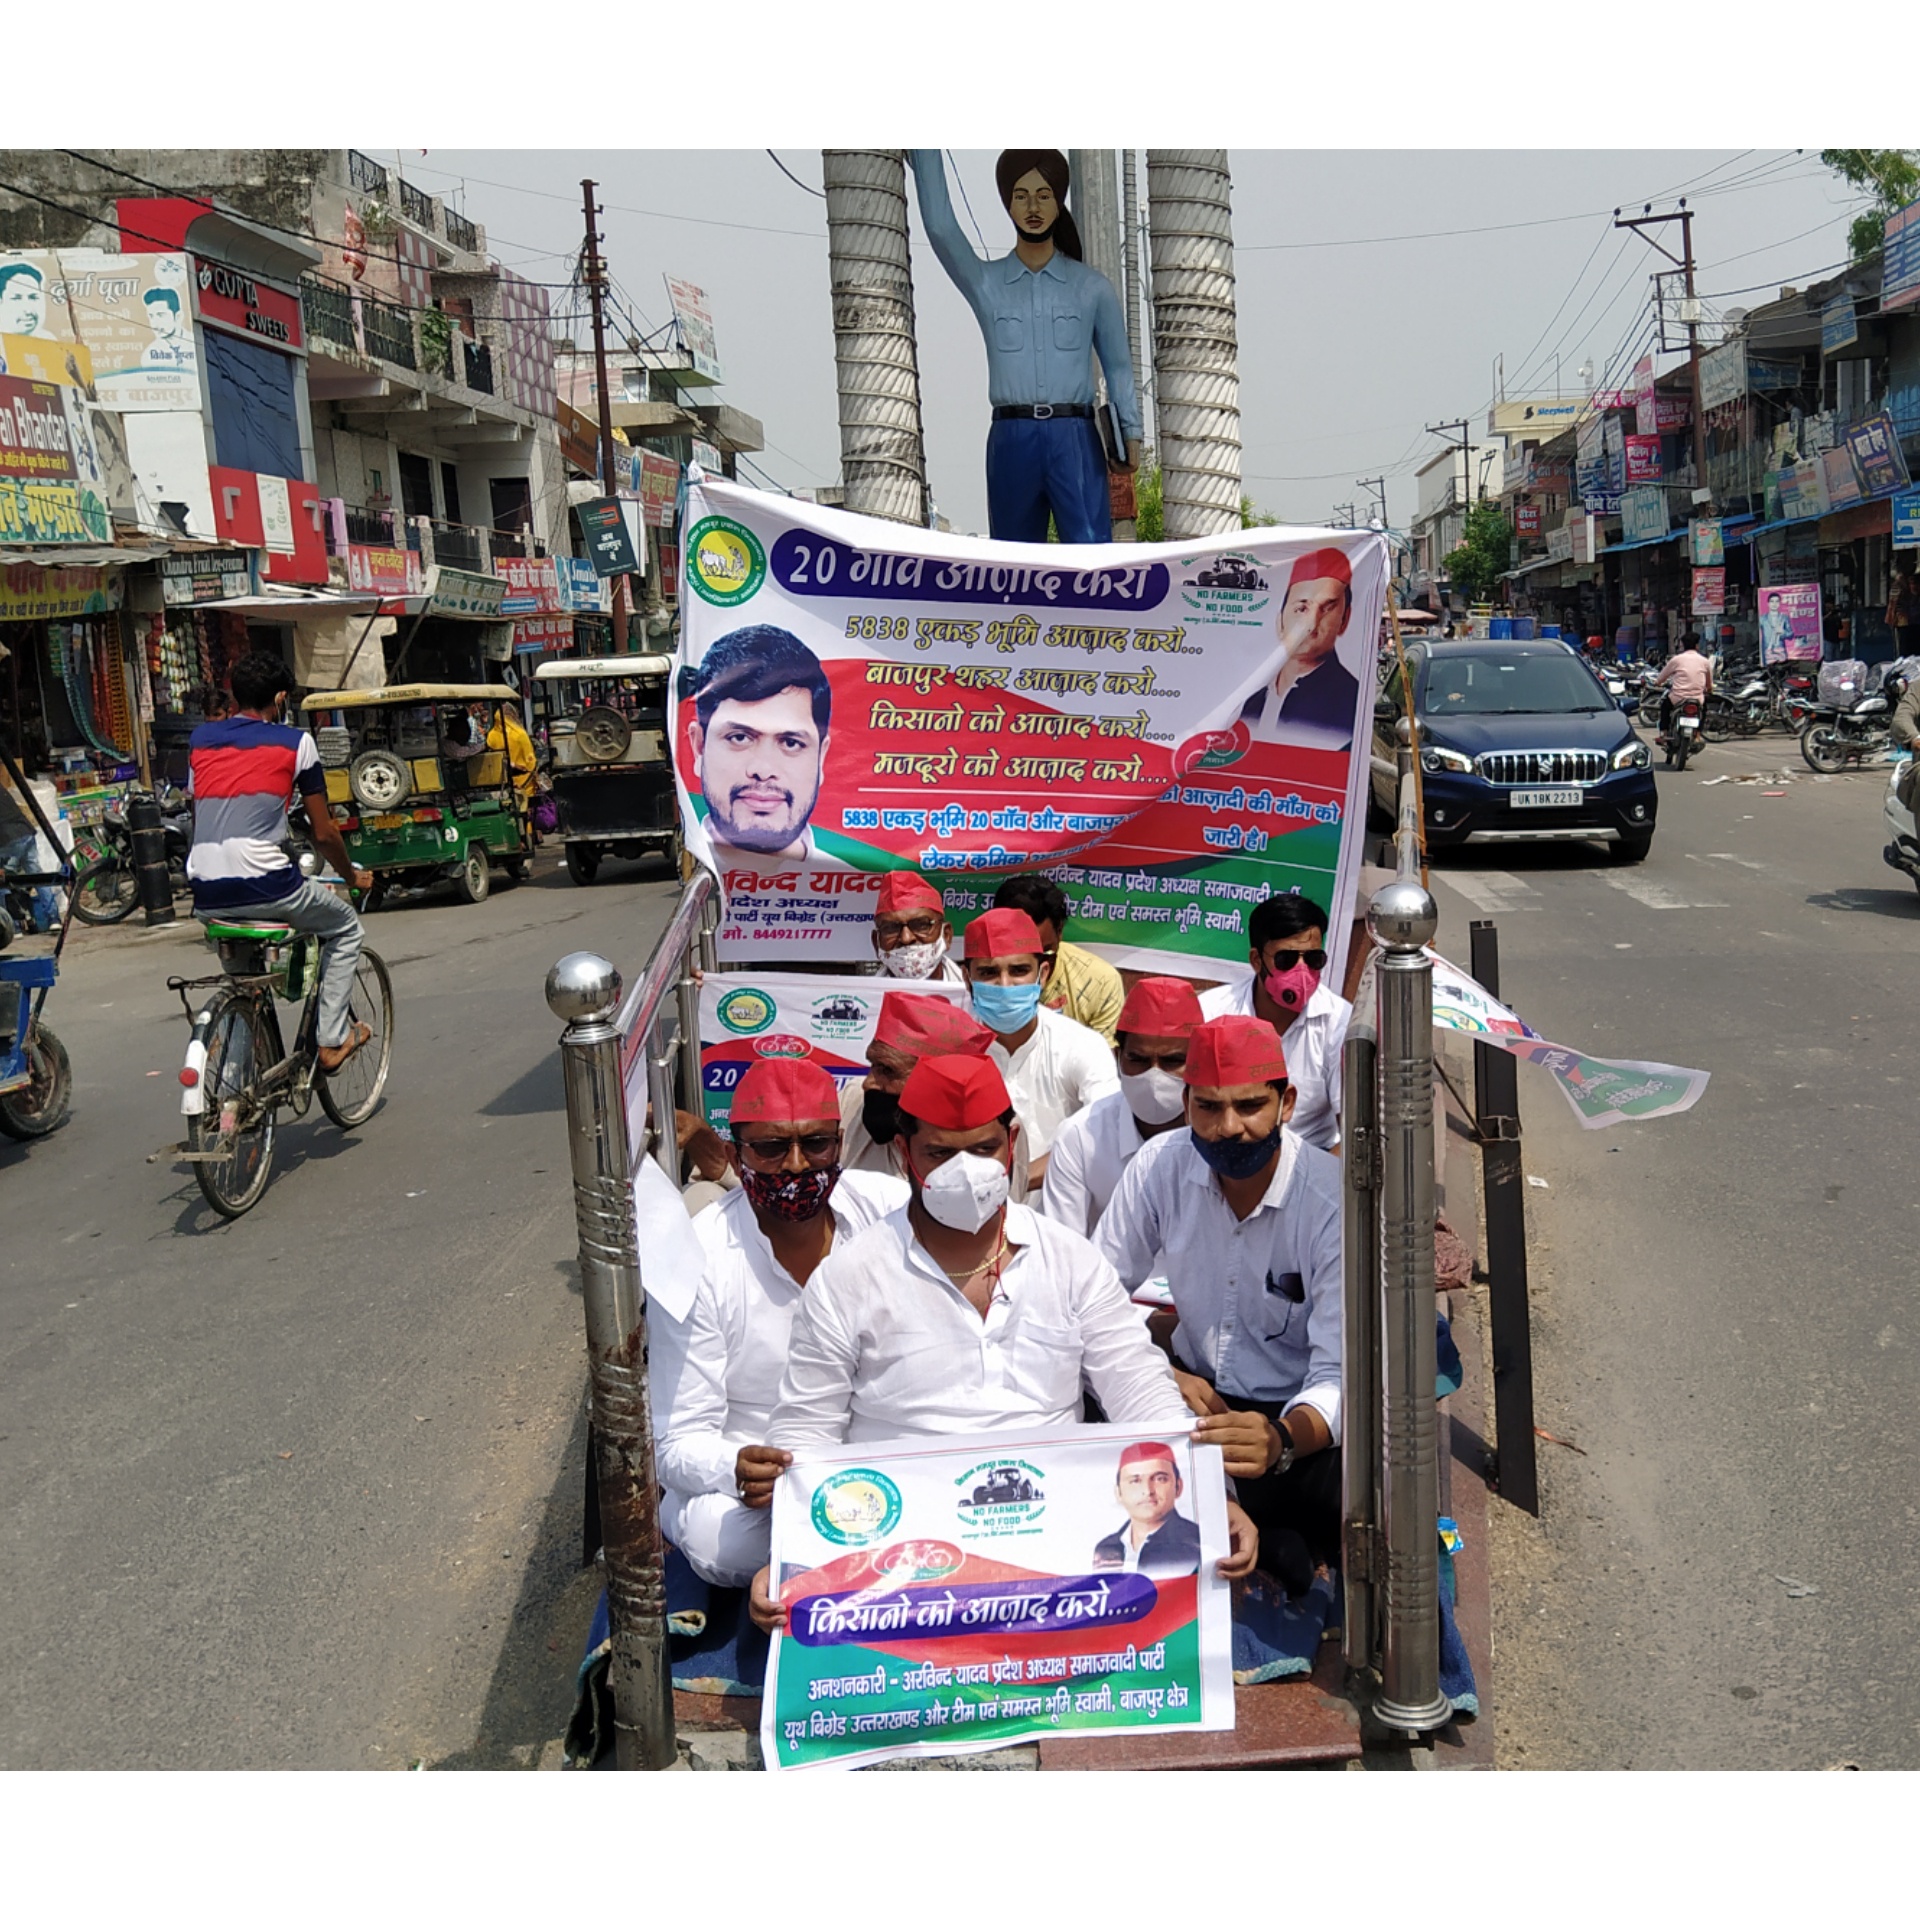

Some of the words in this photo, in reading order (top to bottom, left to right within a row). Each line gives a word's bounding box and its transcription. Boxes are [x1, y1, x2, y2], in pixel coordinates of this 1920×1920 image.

[99, 277, 141, 303] पूजा
[213, 267, 259, 308] GUPTA
[247, 312, 290, 342] SWEETS
[13, 396, 69, 452] Bhandar
[1537, 405, 1576, 416] Sleepwell
[790, 546, 837, 584] 20
[1197, 590, 1208, 599] NO
[1212, 591, 1254, 602] FARMERS
[1206, 603, 1217, 612] NO
[1220, 603, 1243, 613] FOOD
[845, 615, 909, 641] 5838
[916, 617, 982, 650] एकड़
[985, 613, 1041, 653] भूमि
[1043, 624, 1130, 655] आज़ाद
[865, 661, 950, 695] बाजपुर
[955, 665, 1011, 690] शहर
[1014, 667, 1100, 699] आज़ाद
[868, 699, 965, 732] किसानो
[968, 704, 1007, 735] को
[1009, 712, 1096, 743] आज़ाद
[872, 747, 958, 784] मजदूरो
[962, 748, 1000, 779] को
[1003, 753, 1089, 787] आज़ाद
[842, 808, 878, 829] 5838
[882, 808, 926, 834] एकड़
[930, 802, 966, 837] भूमि
[970, 809, 989, 830] 20
[1030, 804, 1064, 832] और
[1248, 789, 1273, 815] की
[1315, 798, 1341, 824] को
[1517, 792, 1531, 805] UK
[1533, 791, 1552, 806] 18K
[1553, 791, 1580, 805] 2213
[920, 843, 968, 870] लेकर
[1203, 823, 1242, 848] जारी
[722, 869, 803, 894] विन्द
[810, 870, 885, 895] यादव
[1088, 869, 1122, 891] यादव
[1125, 871, 1158, 893] प्रदेश
[1159, 875, 1200, 896] अध्यक्ष
[1203, 880, 1272, 904] समाजवादी
[734, 910, 759, 923] पार्टी
[775, 897, 839, 910] अध्यक्ष
[1081, 898, 1106, 920] टीम
[1107, 899, 1130, 921] एवं
[1131, 903, 1172, 924] समस्त
[1174, 904, 1203, 934] भूमि
[722, 926, 747, 940] मो.
[752, 928, 833, 940] 8449217777
[709, 1068, 738, 1087] 20
[973, 1507, 985, 1517] NO
[987, 1503, 1031, 1516] FARMERS
[983, 1517, 995, 1527] NO
[998, 1516, 1021, 1526] FOOD
[808, 1591, 910, 1636] किसानो
[916, 1590, 955, 1628] को
[960, 1592, 1049, 1630] आज़ाद
[807, 1664, 887, 1701] अनशनकारी
[902, 1660, 953, 1692] अरविन्द
[955, 1662, 990, 1687] यादव
[991, 1653, 1023, 1689] प्रदेश
[1025, 1654, 1068, 1681] अध्यक्ष
[1069, 1645, 1137, 1677] समाजवादी
[1139, 1641, 1166, 1671] पार्टी
[783, 1718, 807, 1750] यूथ
[922, 1699, 950, 1728] और
[951, 1695, 976, 1724] टीम
[977, 1691, 999, 1721] एवं
[1000, 1694, 1042, 1719] समस्त
[1044, 1685, 1072, 1725] भूमि
[1119, 1688, 1164, 1718] बाजपुर
[1166, 1680, 1190, 1709] क्षेत्र
